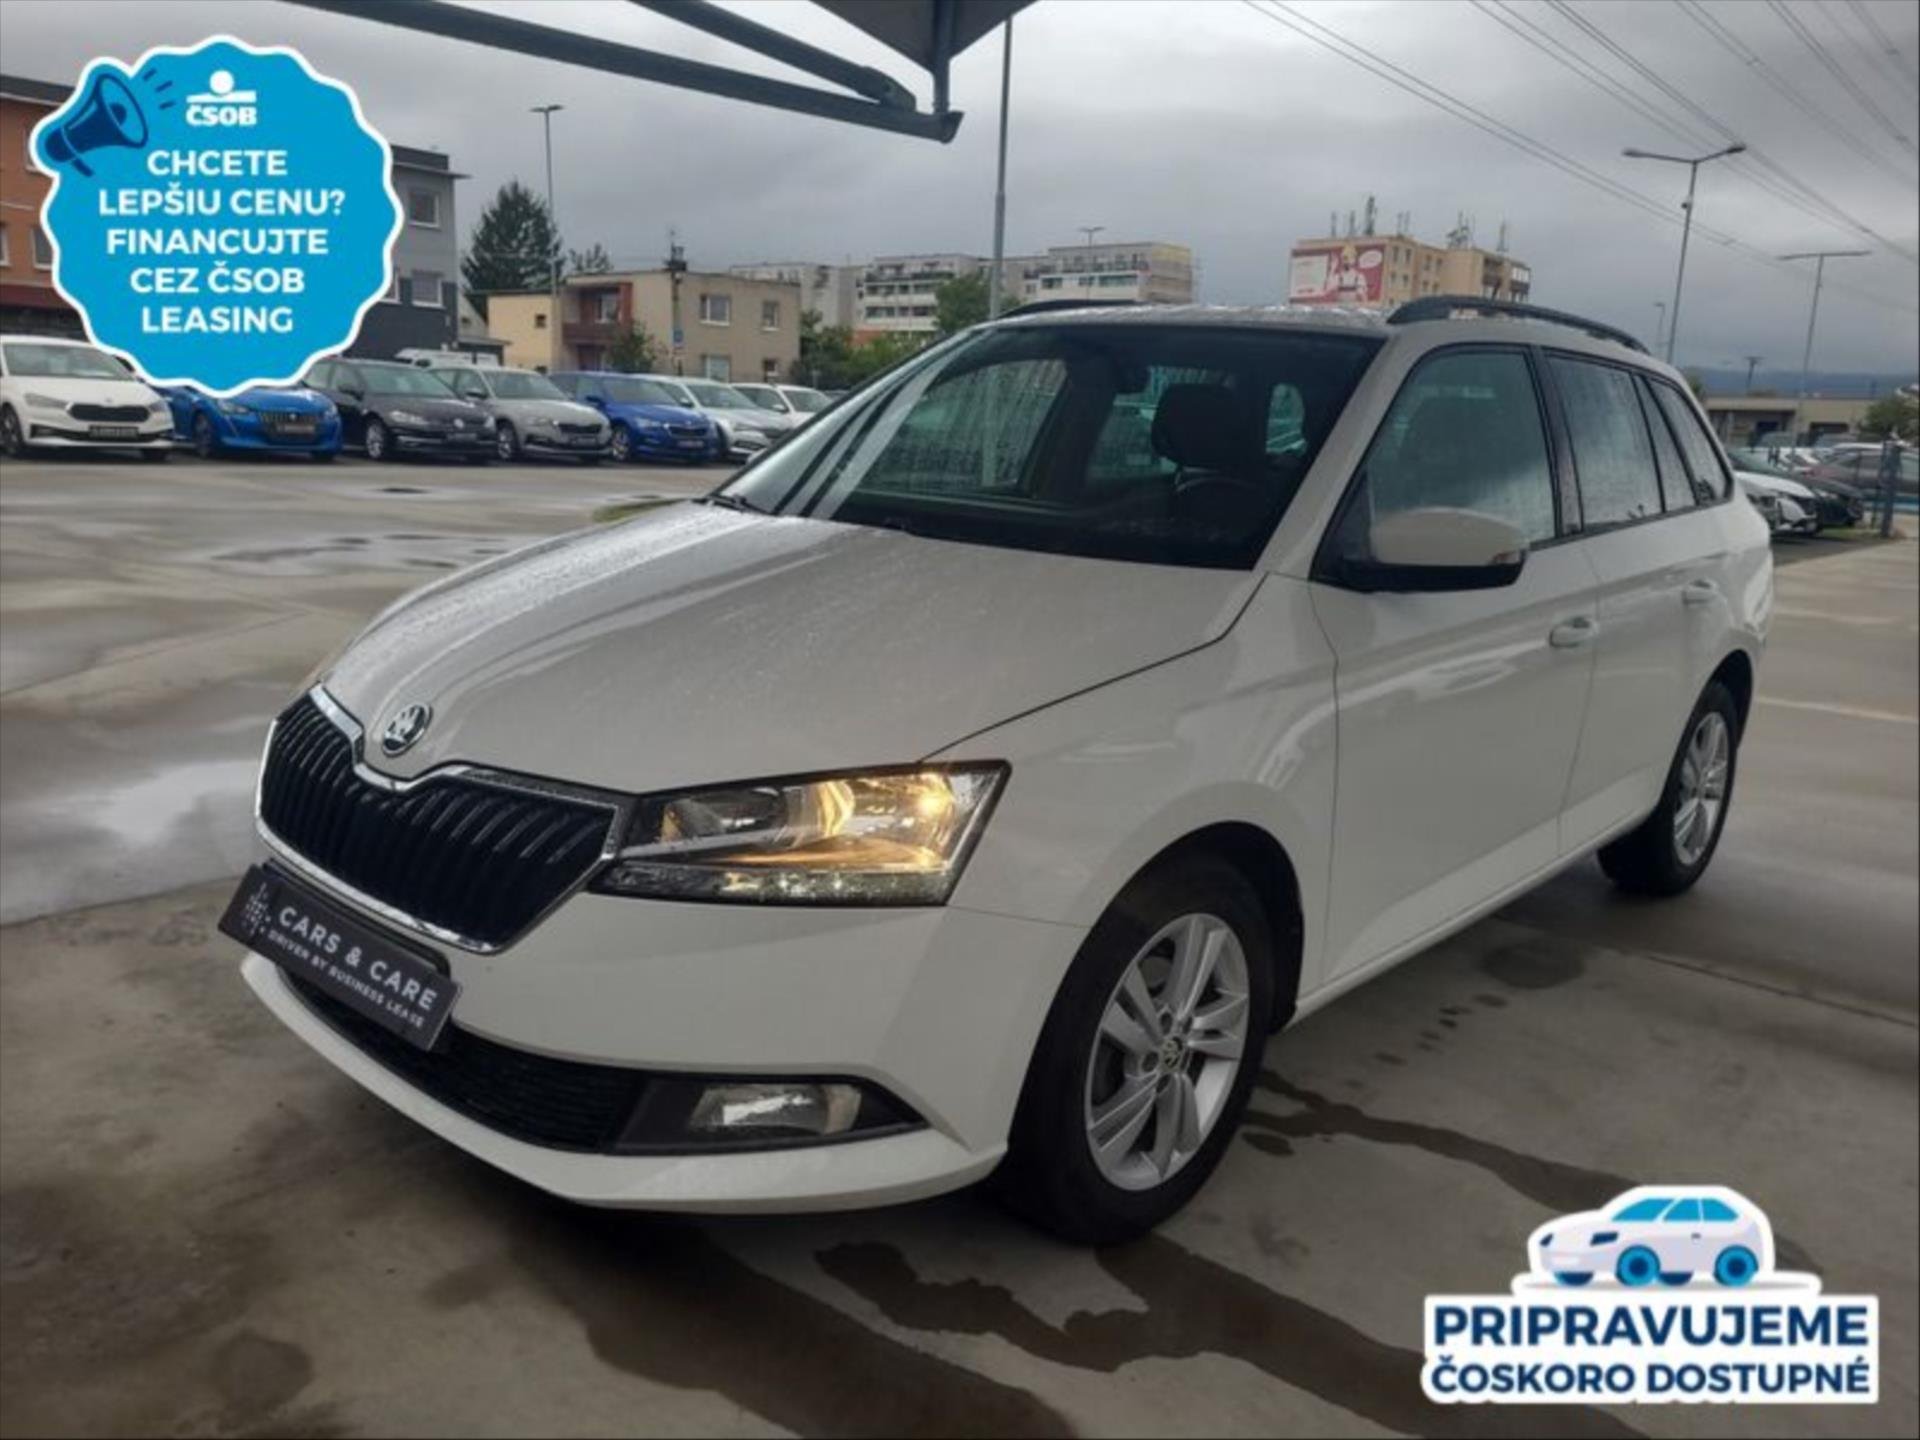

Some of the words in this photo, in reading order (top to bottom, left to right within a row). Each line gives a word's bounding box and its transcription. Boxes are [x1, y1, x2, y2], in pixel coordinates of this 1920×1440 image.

[278, 907, 341, 953] CARS
[345, 946, 363, 968] &
[369, 961, 438, 1010] CARE
[385, 999, 425, 1028] LEASE
